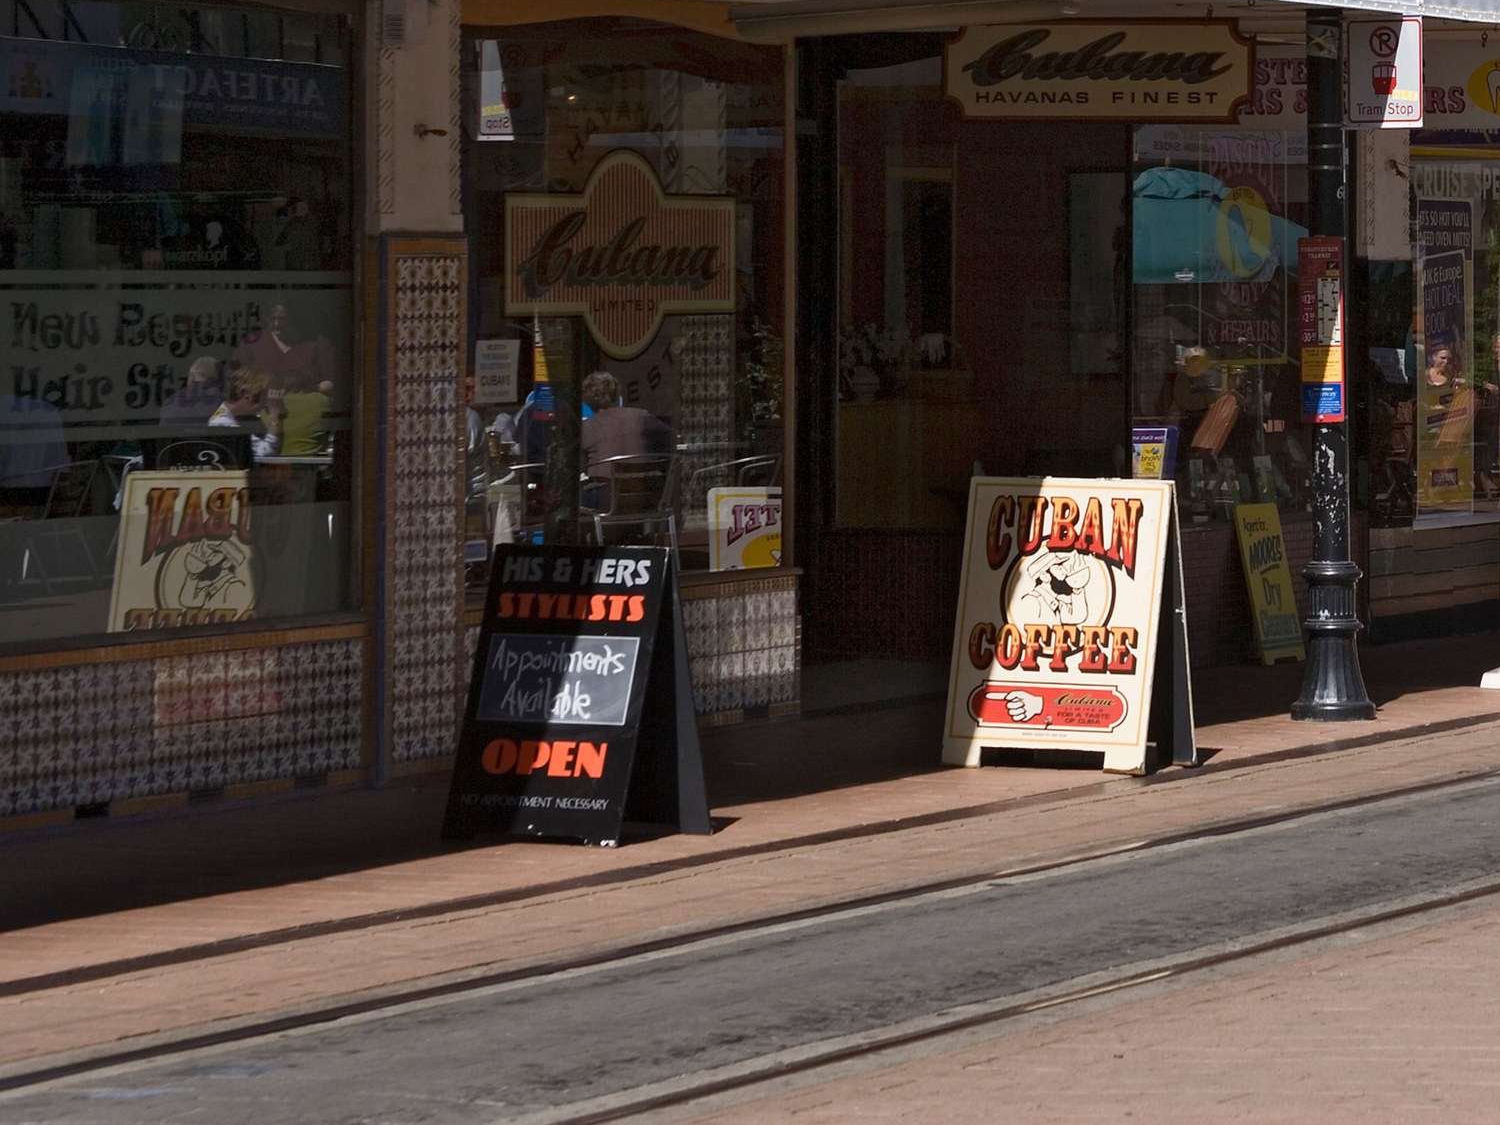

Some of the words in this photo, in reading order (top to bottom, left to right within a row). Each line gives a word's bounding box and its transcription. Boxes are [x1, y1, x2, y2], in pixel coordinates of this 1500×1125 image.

[962, 28, 1235, 86] Cubana
[975, 90, 1089, 105] HAVANAS
[1111, 90, 1219, 105] FINEST
[1356, 103, 1382, 115] Tram
[1388, 103, 1413, 117] Stop
[518, 211, 720, 291] Cubana
[9, 301, 100, 352] New
[987, 495, 1144, 580] CUBAN
[503, 556, 545, 584] HIS
[552, 557, 573, 580] &
[580, 559, 652, 587] HERS
[497, 592, 646, 622] STYLISTS
[490, 638, 626, 683] Appointments
[969, 623, 1138, 675] COFFEE
[500, 680, 592, 720] Available
[1057, 691, 1115, 707] Cubana
[481, 737, 609, 779] OPEN
[555, 797, 609, 811] NECESSARY
